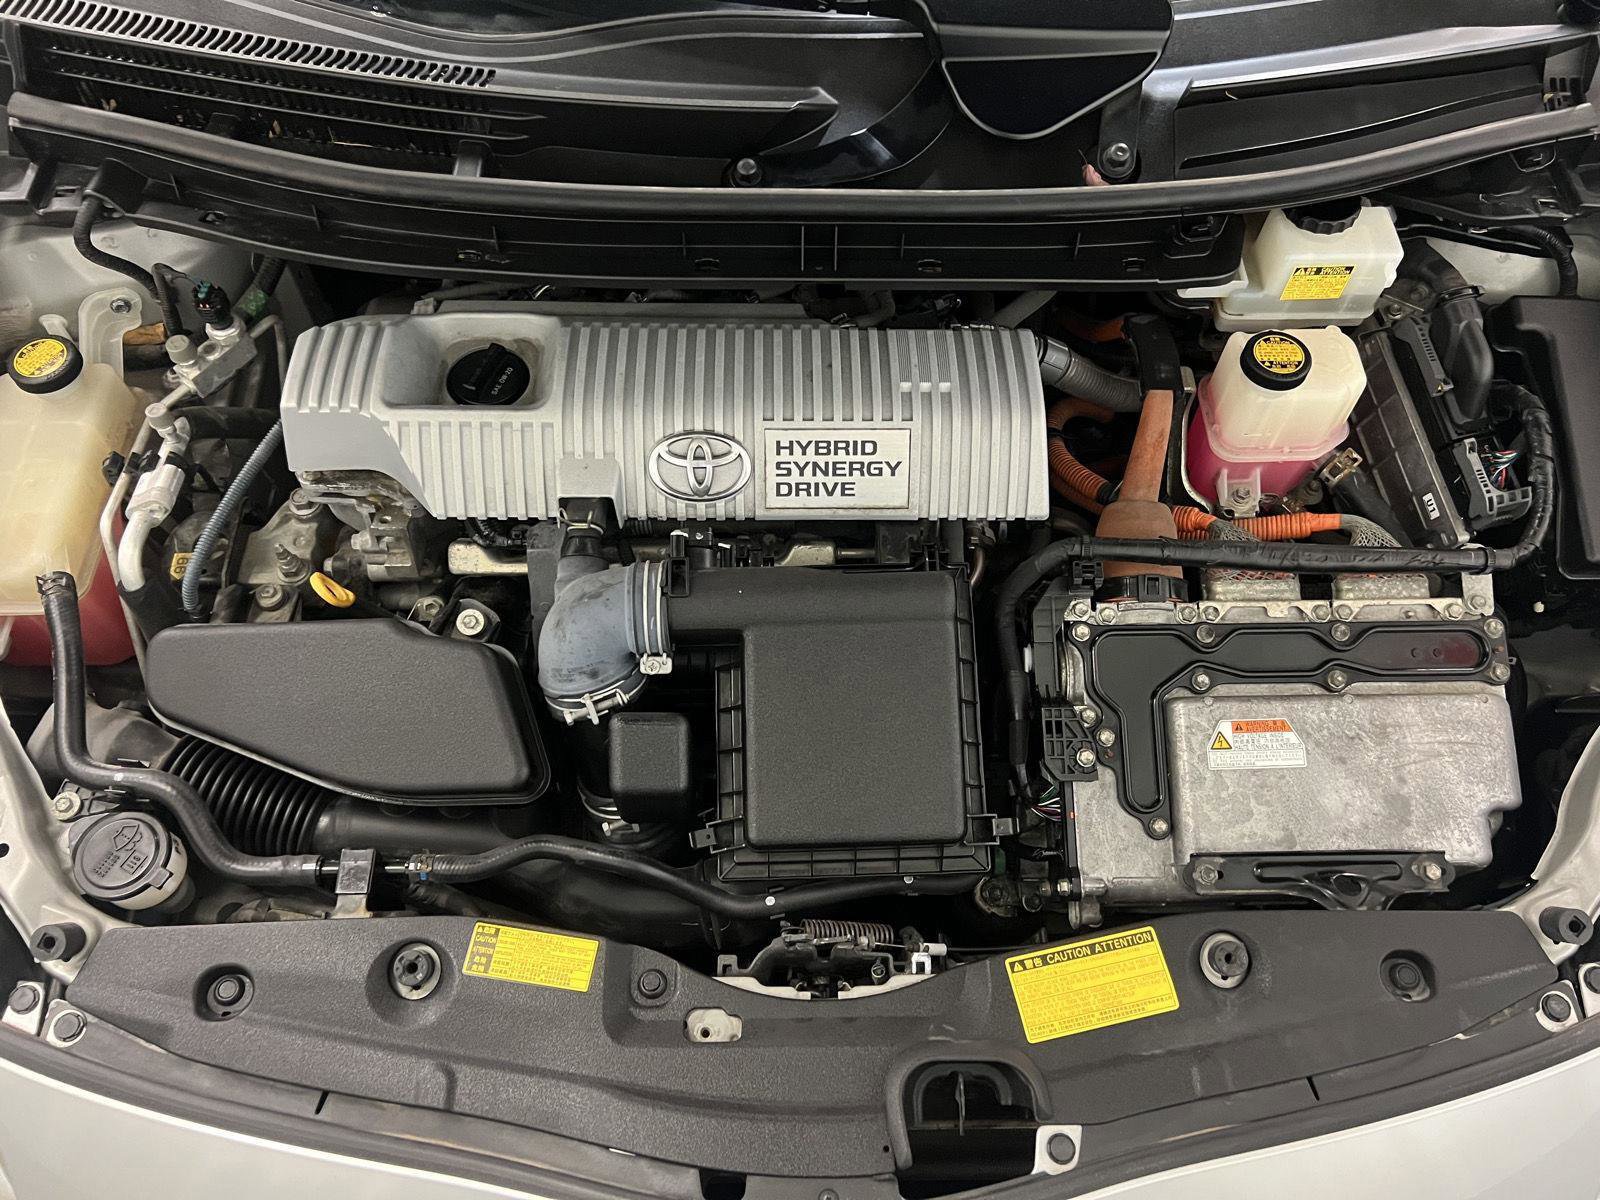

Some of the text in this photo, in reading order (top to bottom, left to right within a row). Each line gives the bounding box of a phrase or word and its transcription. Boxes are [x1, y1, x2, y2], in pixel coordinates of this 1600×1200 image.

[775, 440, 878, 456] HYBRID
[775, 461, 903, 477] SYNERGY
[775, 482, 856, 497] DRIVE
[1426, 498, 1436, 513] U1
[475, 934, 498, 944] CAUTION
[1046, 946, 1091, 964] CAUTION
[1095, 931, 1152, 953] ATTENTION
